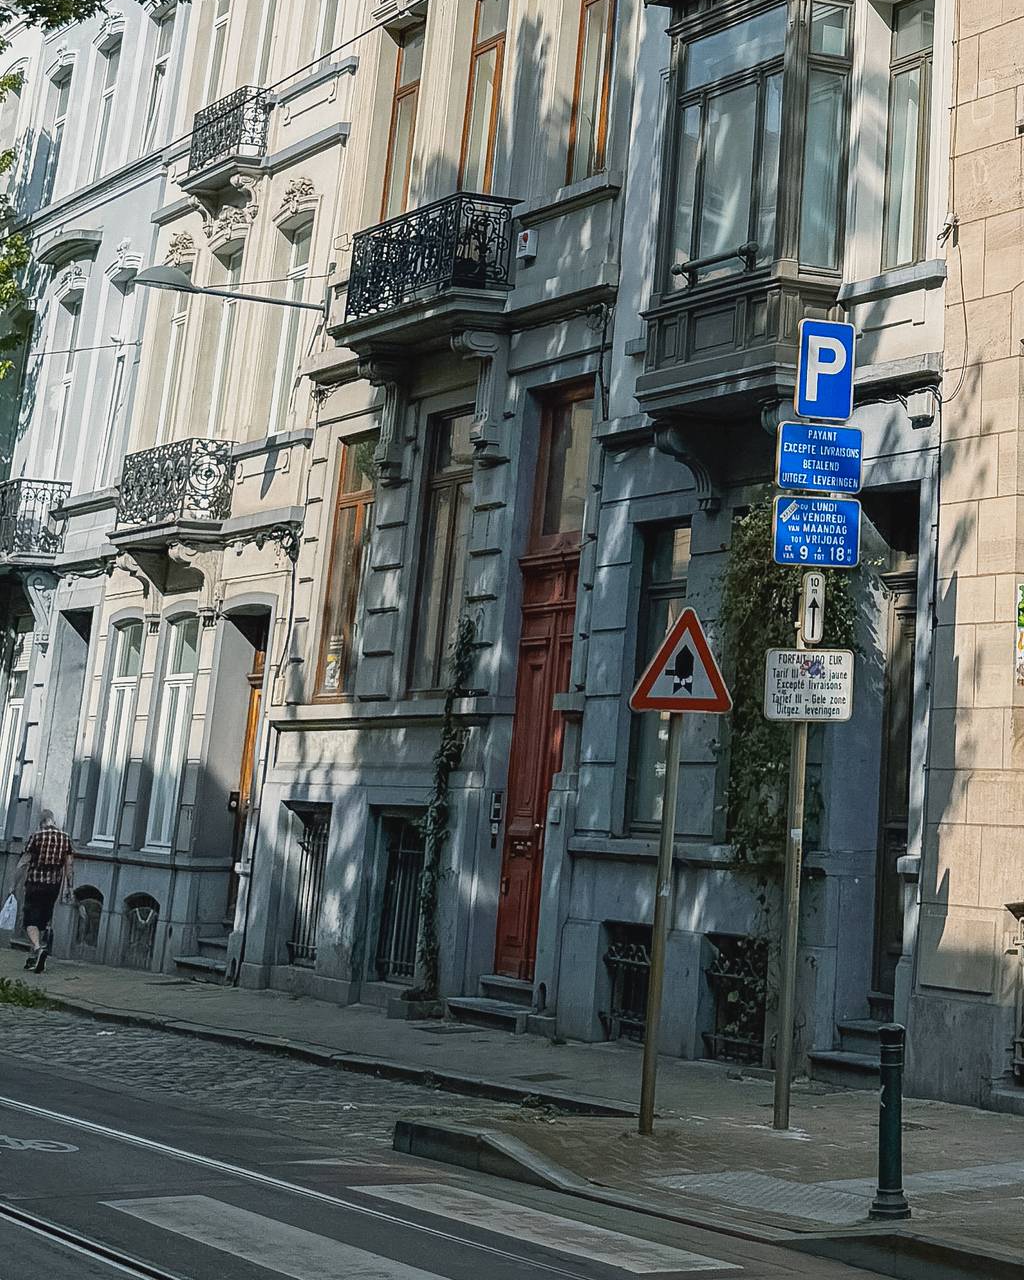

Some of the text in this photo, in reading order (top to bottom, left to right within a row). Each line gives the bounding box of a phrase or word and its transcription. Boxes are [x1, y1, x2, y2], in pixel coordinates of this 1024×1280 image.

[805, 334, 847, 401] P
[807, 429, 838, 441] PAYANT
[820, 445, 860, 458] LIVRAISONS
[802, 459, 840, 471] BETALEND
[812, 474, 859, 488] LEVERINGEN
[811, 502, 838, 511] LUNDI
[802, 512, 846, 523] VENDREDI
[802, 523, 848, 534] MAANDAG
[805, 534, 845, 545] VRIJDAG
[799, 545, 809, 559] 9
[830, 546, 845, 561] 18
[810, 577, 820, 586] 10
[778, 653, 807, 664] FORFAIT
[828, 655, 843, 665] EUR
[772, 668, 789, 678] Tarif
[828, 669, 848, 681] jaune
[776, 679, 805, 692] Excepté
[808, 679, 842, 690] livraisons
[772, 693, 793, 704] Tarief
[811, 694, 827, 704] Gele
[829, 695, 847, 704] zone
[804, 704, 841, 717] leveringen
